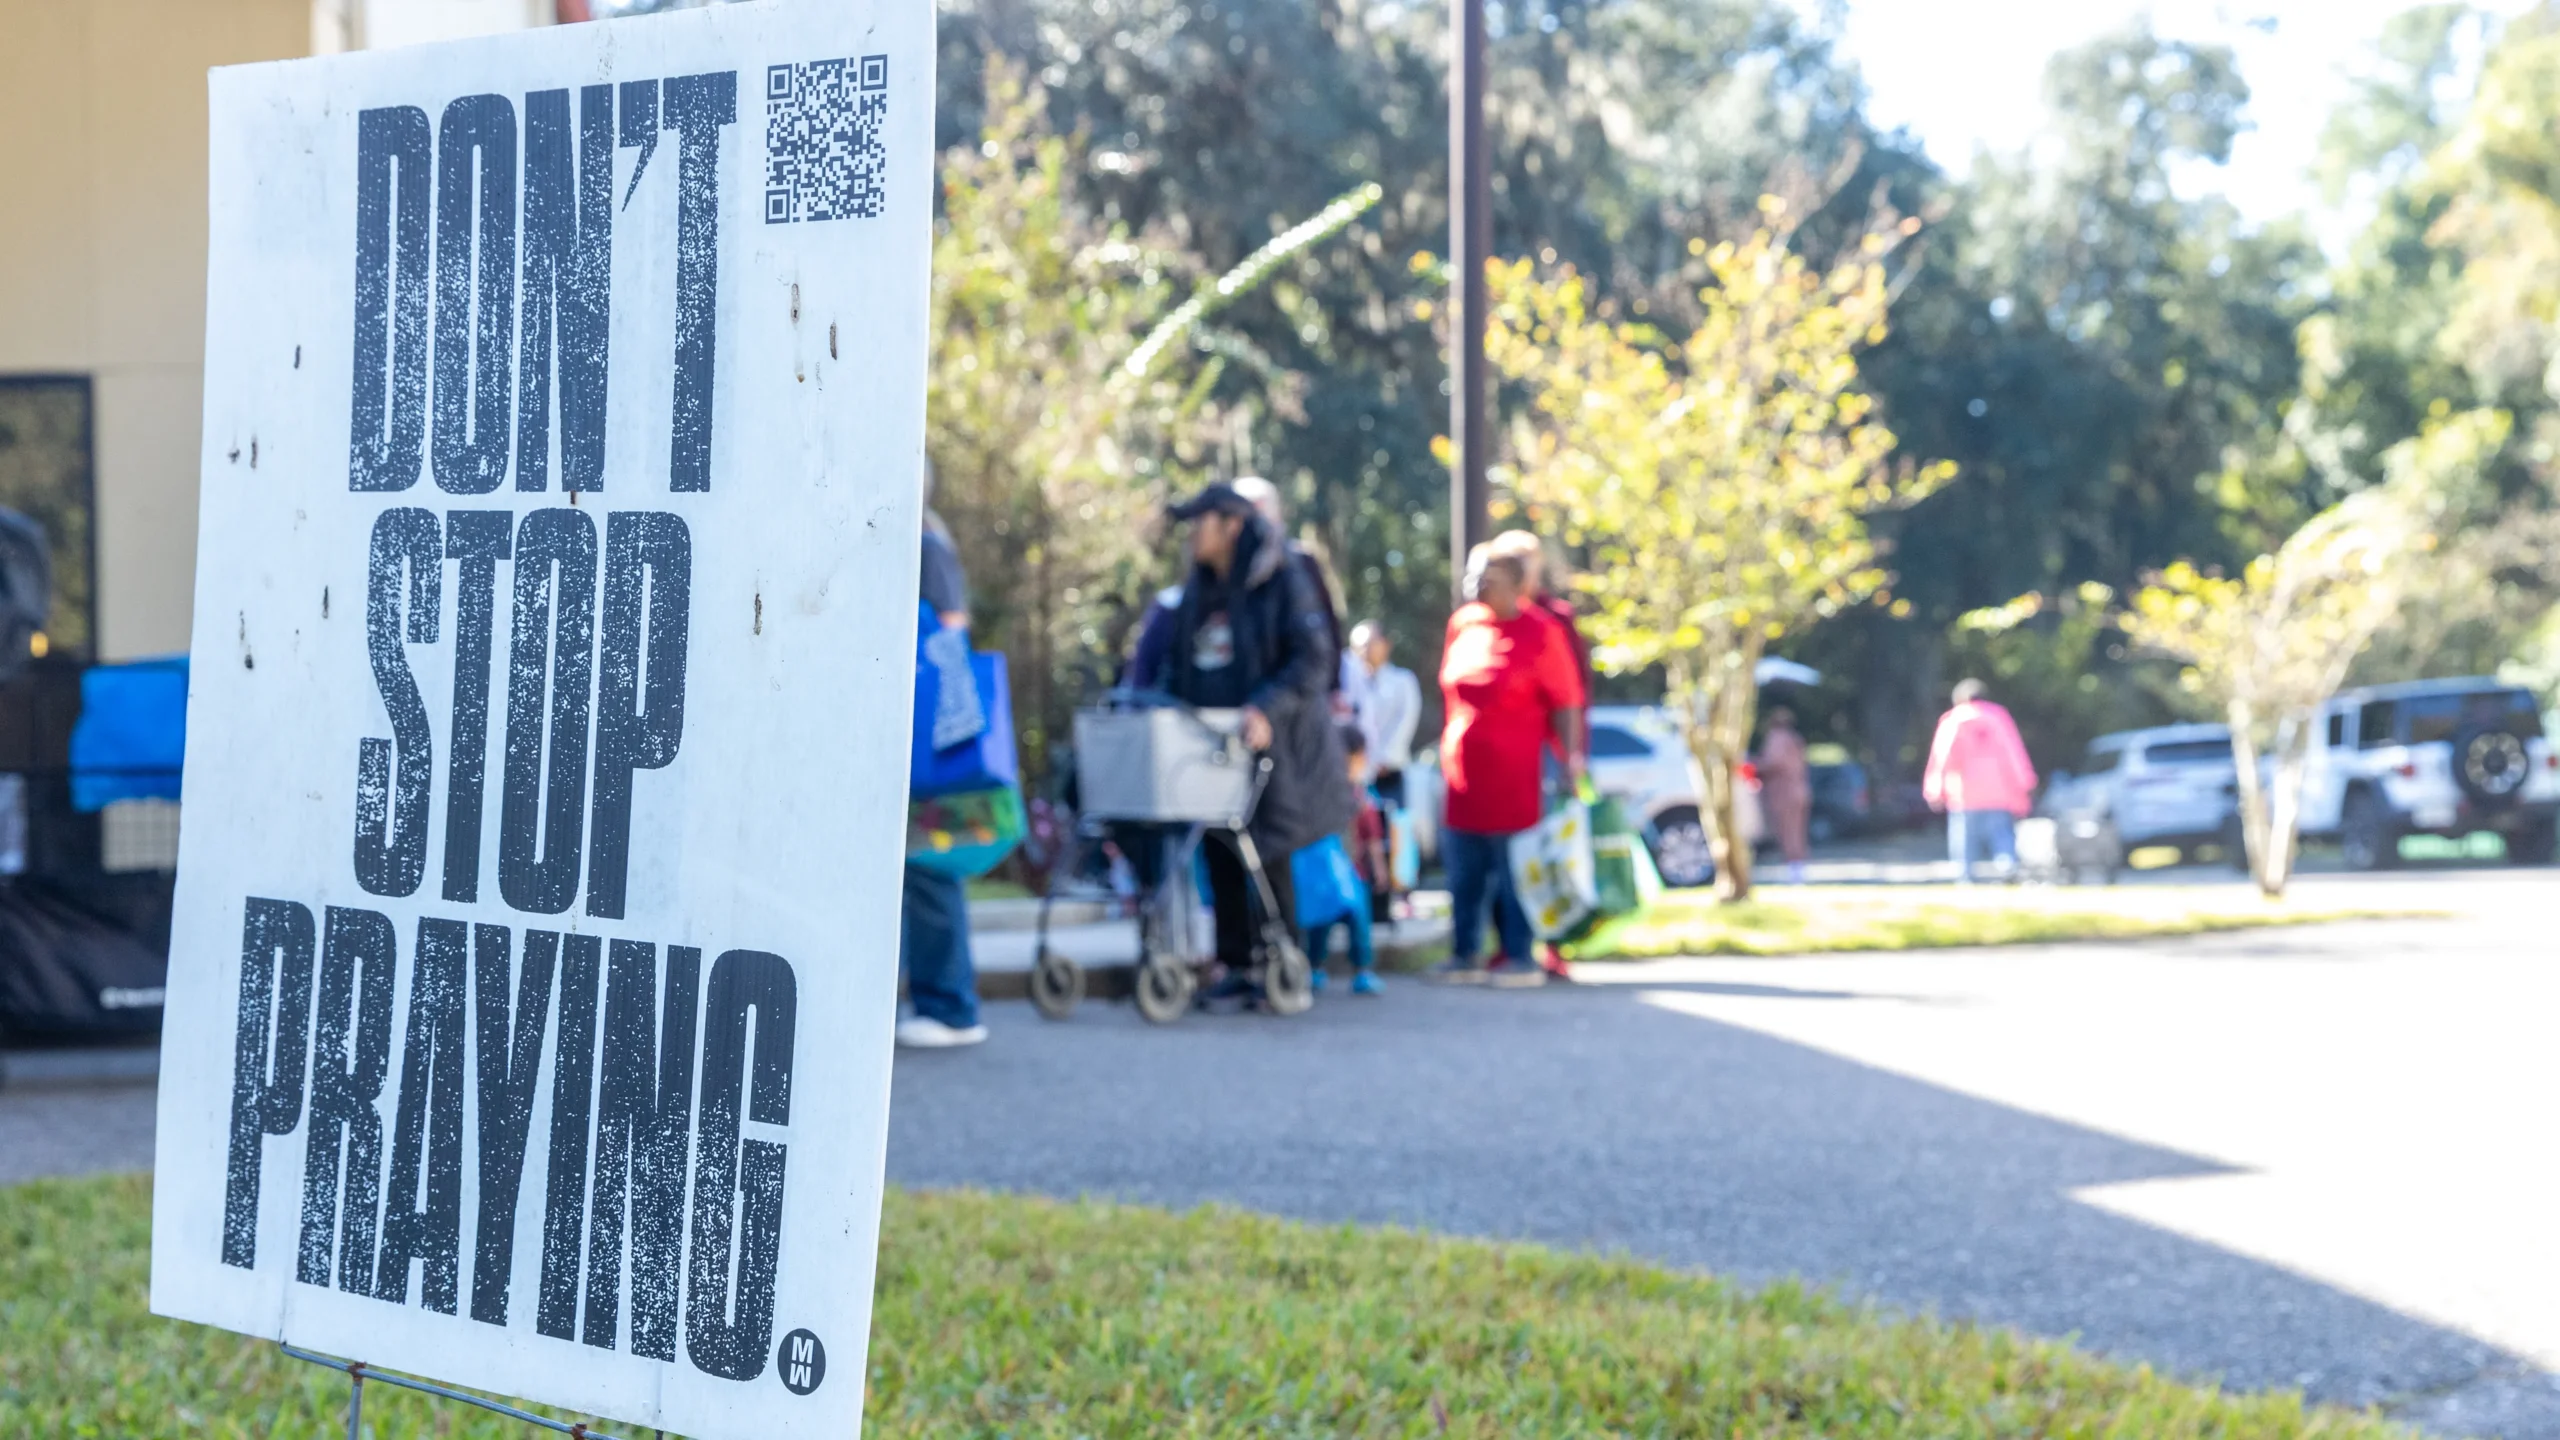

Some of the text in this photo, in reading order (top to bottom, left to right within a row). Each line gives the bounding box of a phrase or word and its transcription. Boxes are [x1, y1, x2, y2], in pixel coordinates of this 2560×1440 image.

[350, 71, 737, 494] DON'T
[354, 508, 692, 921] STOP
[222, 897, 797, 1382] PRAYING
